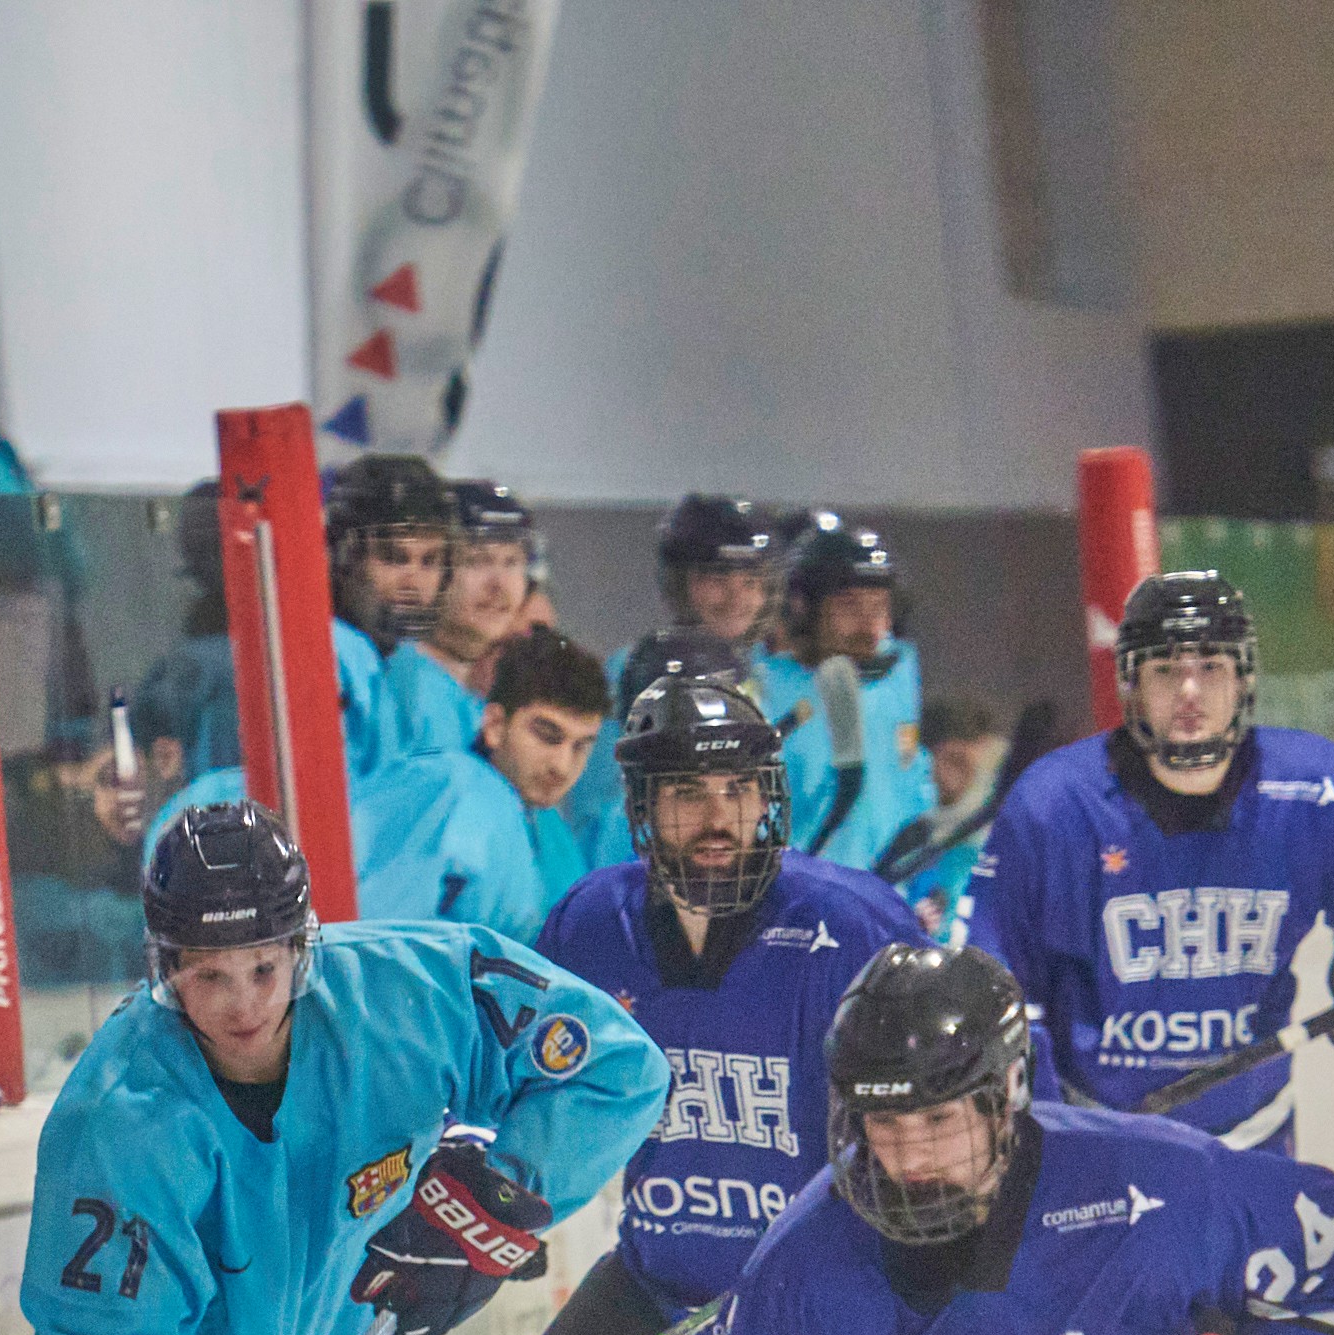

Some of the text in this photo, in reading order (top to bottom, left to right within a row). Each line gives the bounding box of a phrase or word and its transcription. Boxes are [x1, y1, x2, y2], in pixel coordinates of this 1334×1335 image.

[695, 739, 741, 750] CCM
[202, 907, 257, 923] BAUER
[1102, 886, 1290, 984] CHH
[649, 1048, 799, 1158] HH
[854, 1082, 913, 1096] CCM
[627, 1175, 795, 1226] OSne
[60, 1197, 149, 1300] 21
